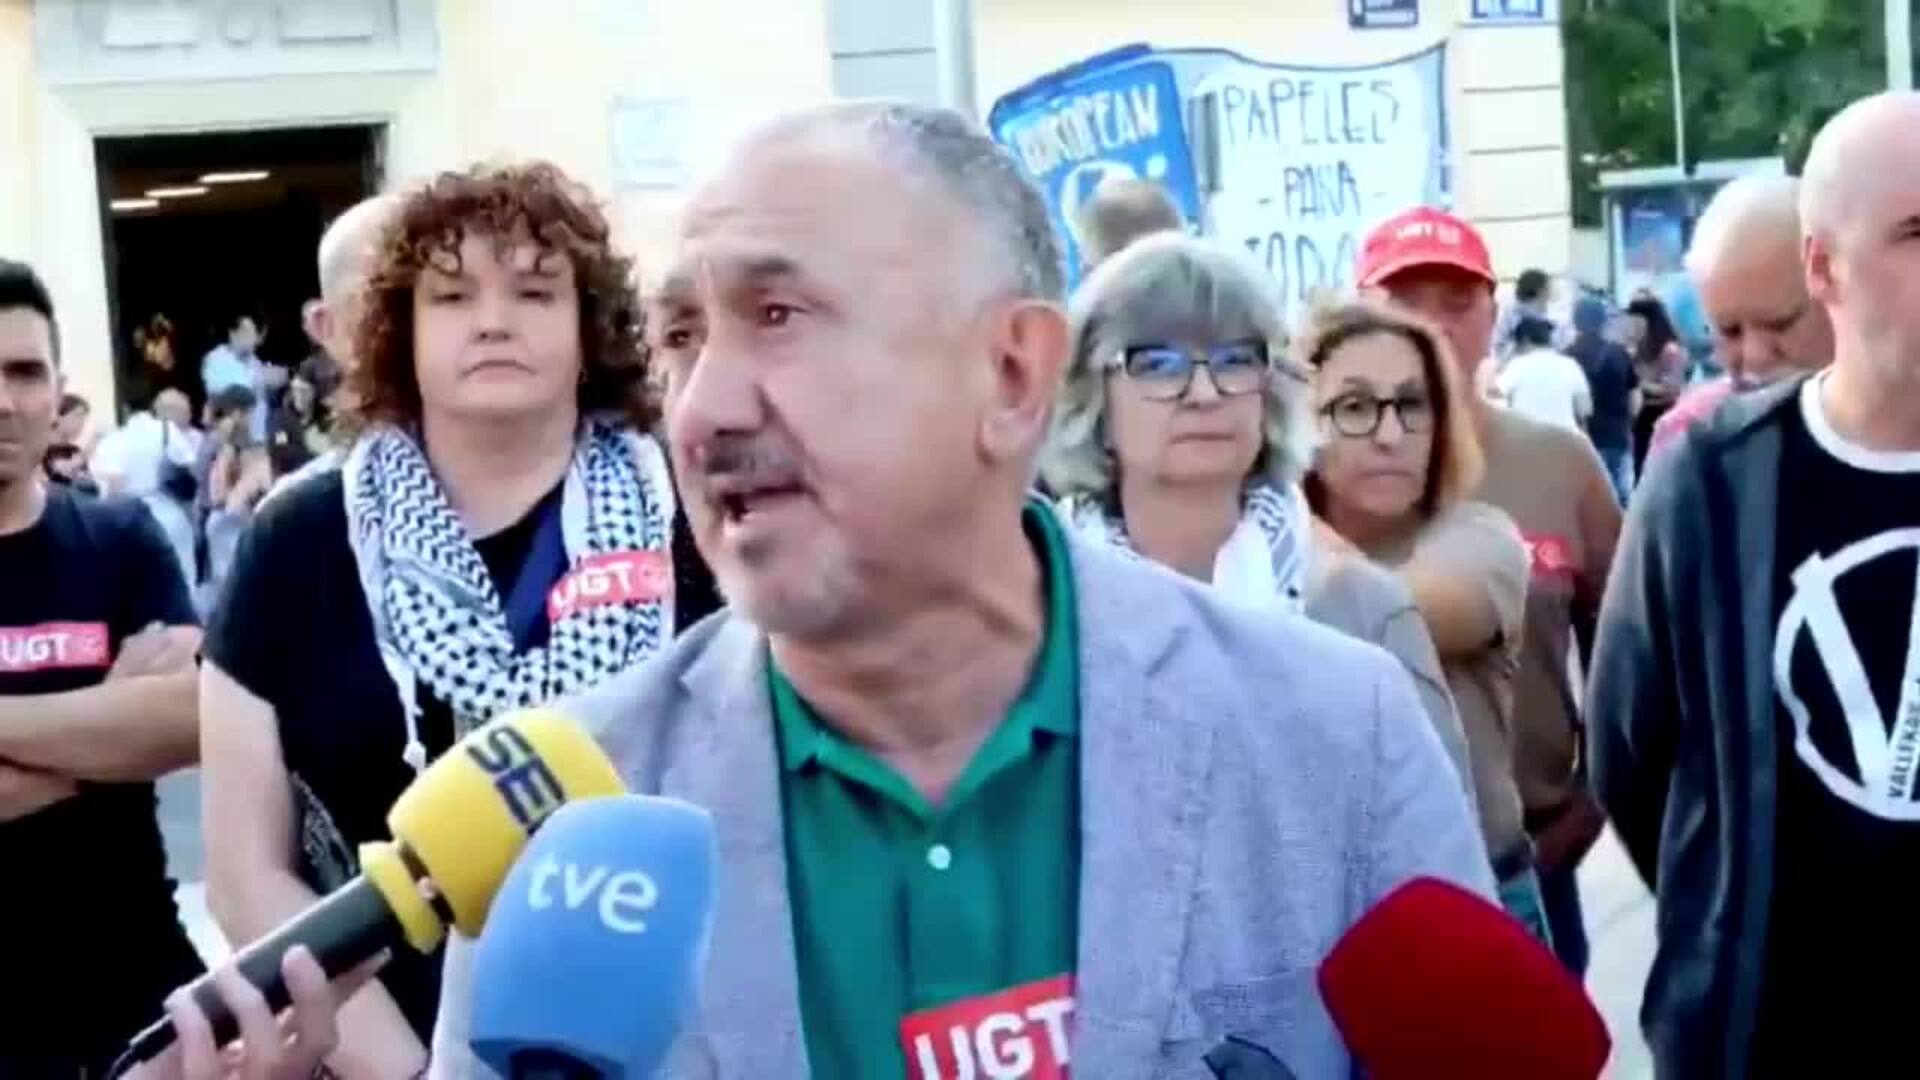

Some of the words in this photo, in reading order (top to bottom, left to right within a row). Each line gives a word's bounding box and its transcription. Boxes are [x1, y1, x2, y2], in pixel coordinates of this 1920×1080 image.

[1223, 78, 1400, 144] PAPELES
[551, 560, 634, 609] UGT
[1, 632, 72, 665] UGT
[527, 852, 658, 935] tve
[914, 997, 1076, 1080] UGT
